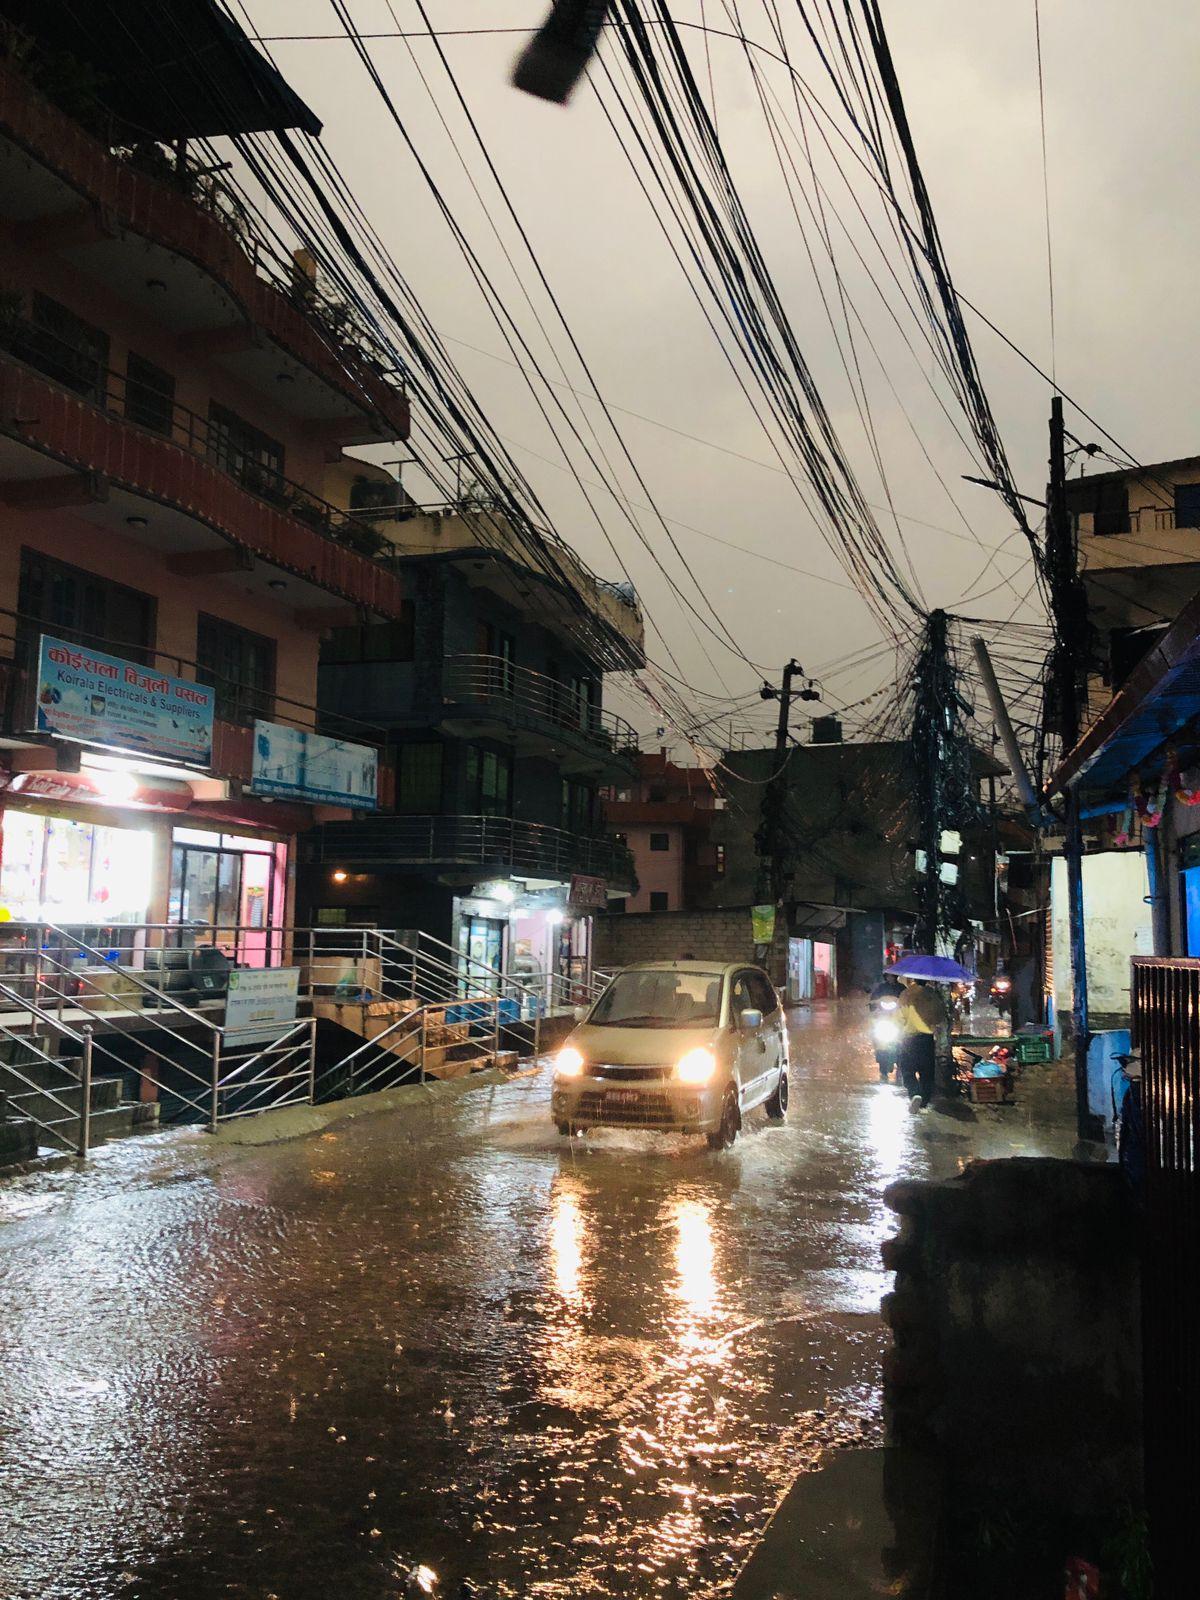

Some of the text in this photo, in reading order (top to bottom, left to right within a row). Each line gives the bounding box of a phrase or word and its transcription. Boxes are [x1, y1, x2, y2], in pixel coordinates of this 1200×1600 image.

[58, 670, 200, 718] Koirala Electricals & Suppliers
[125, 666, 169, 694] बिजुली
[175, 687, 207, 705] पसल
